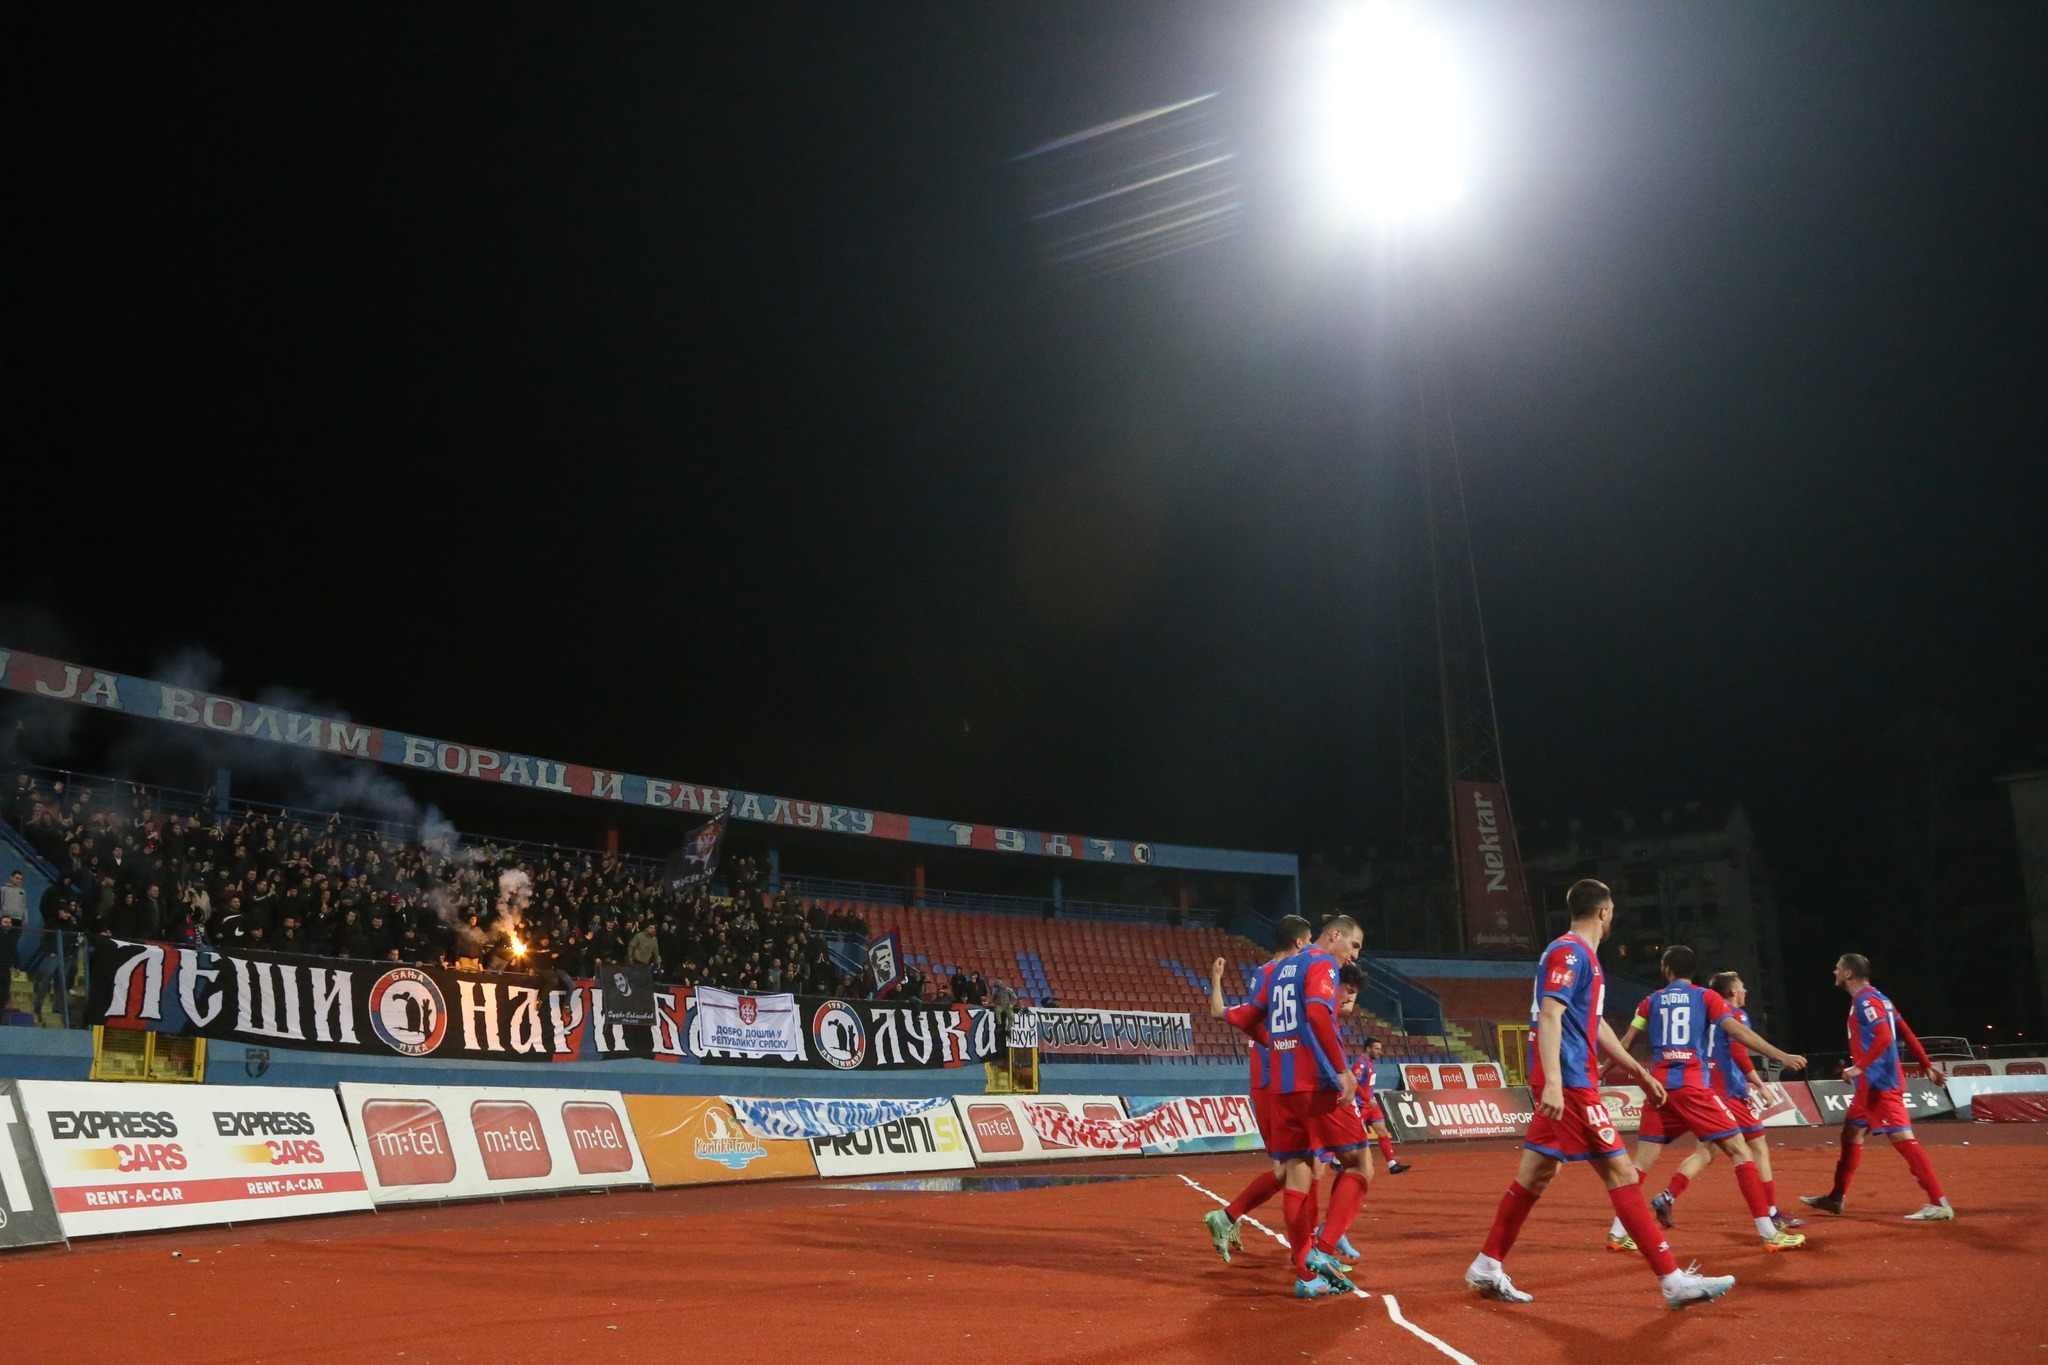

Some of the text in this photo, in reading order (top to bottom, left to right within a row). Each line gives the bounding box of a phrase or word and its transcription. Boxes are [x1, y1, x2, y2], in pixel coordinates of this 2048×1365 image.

[157, 686, 372, 757] ВОЛИМ
[402, 735, 573, 794] БОРАЦ
[591, 770, 624, 800] И
[1473, 791, 1508, 894] Nektar
[391, 970, 424, 983] БАЊА
[1271, 983, 1298, 1034] 26
[1013, 1012, 1036, 1029] АТО
[1659, 1006, 1691, 1046] 18
[711, 1035, 789, 1049] РЕПУБЛИКУ СРПСКУ
[716, 1025, 783, 1039] ДОБРО ДОШЛИ У
[399, 1043, 429, 1054] ЛУКА
[1662, 1050, 1693, 1060] Nektar
[1408, 1073, 1430, 1084] m:tel
[1442, 1072, 1464, 1083] m:tel
[1476, 1071, 1498, 1082] m:tel
[1428, 1099, 1535, 1127] Juventa SPOR
[1586, 1103, 1610, 1128] 44
[47, 1111, 179, 1139] EXPRESS
[212, 1111, 316, 1137] EXPRESS
[976, 1117, 1016, 1137] m:tel
[1440, 1125, 1516, 1137] www.juventasport.com
[376, 1124, 444, 1156] m:tel
[483, 1122, 542, 1153] m:tel
[573, 1122, 623, 1150] m:tel
[731, 1137, 760, 1153] Travel
[112, 1143, 188, 1173] CARS
[265, 1140, 325, 1166] CARS
[85, 1187, 184, 1206] RENT-A-CAR
[247, 1178, 324, 1195] RENT-A-CAR
